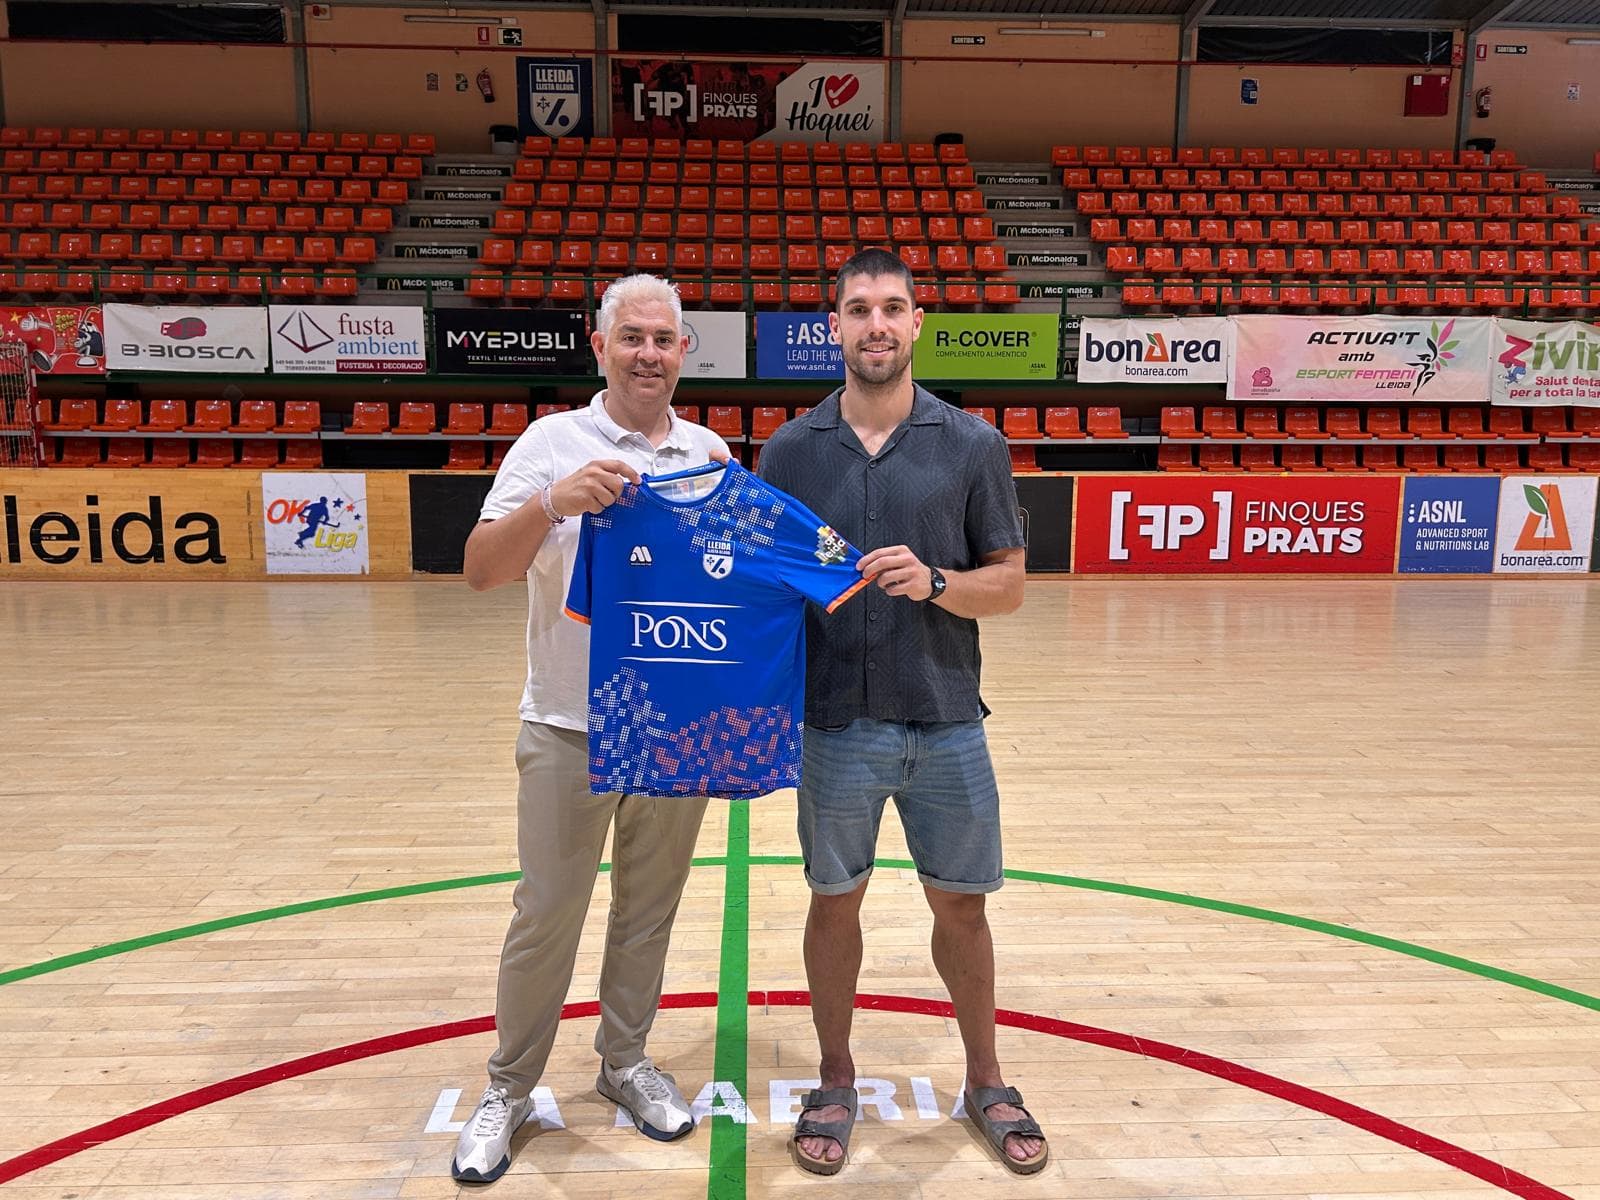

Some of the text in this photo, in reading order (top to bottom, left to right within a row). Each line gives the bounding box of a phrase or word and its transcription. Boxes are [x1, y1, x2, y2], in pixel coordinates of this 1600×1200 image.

[536, 69, 575, 82] LLEIDA
[703, 93, 758, 105] FINQUES
[703, 106, 758, 118] PRATS
[785, 102, 873, 142] Hoquei
[1020, 226, 1065, 234] McDonald's
[419, 247, 468, 255] McDonald's
[337, 312, 394, 336] fusta
[337, 336, 420, 355] ambient
[446, 330, 575, 350] MYEPUBLI
[787, 350, 809, 362] LEAD
[811, 350, 827, 361] THE
[1338, 352, 1375, 362] amb
[1125, 366, 1188, 377] bonarea.com
[1535, 376, 1568, 386] Salut
[1510, 389, 1531, 399] per
[1545, 388, 1573, 397] tota
[1576, 387, 1585, 397] la
[267, 499, 311, 524] OK
[1244, 501, 1365, 525] FINQUES
[1416, 529, 1489, 538] ADVANCED SPORT
[314, 528, 358, 552] Liga
[707, 541, 732, 550] LLEIDA
[1243, 527, 1363, 553] PRATS
[1416, 541, 1489, 551] & NUTRITIONS LAB
[1500, 553, 1584, 567] bonarea.com
[631, 611, 728, 652] PONS
